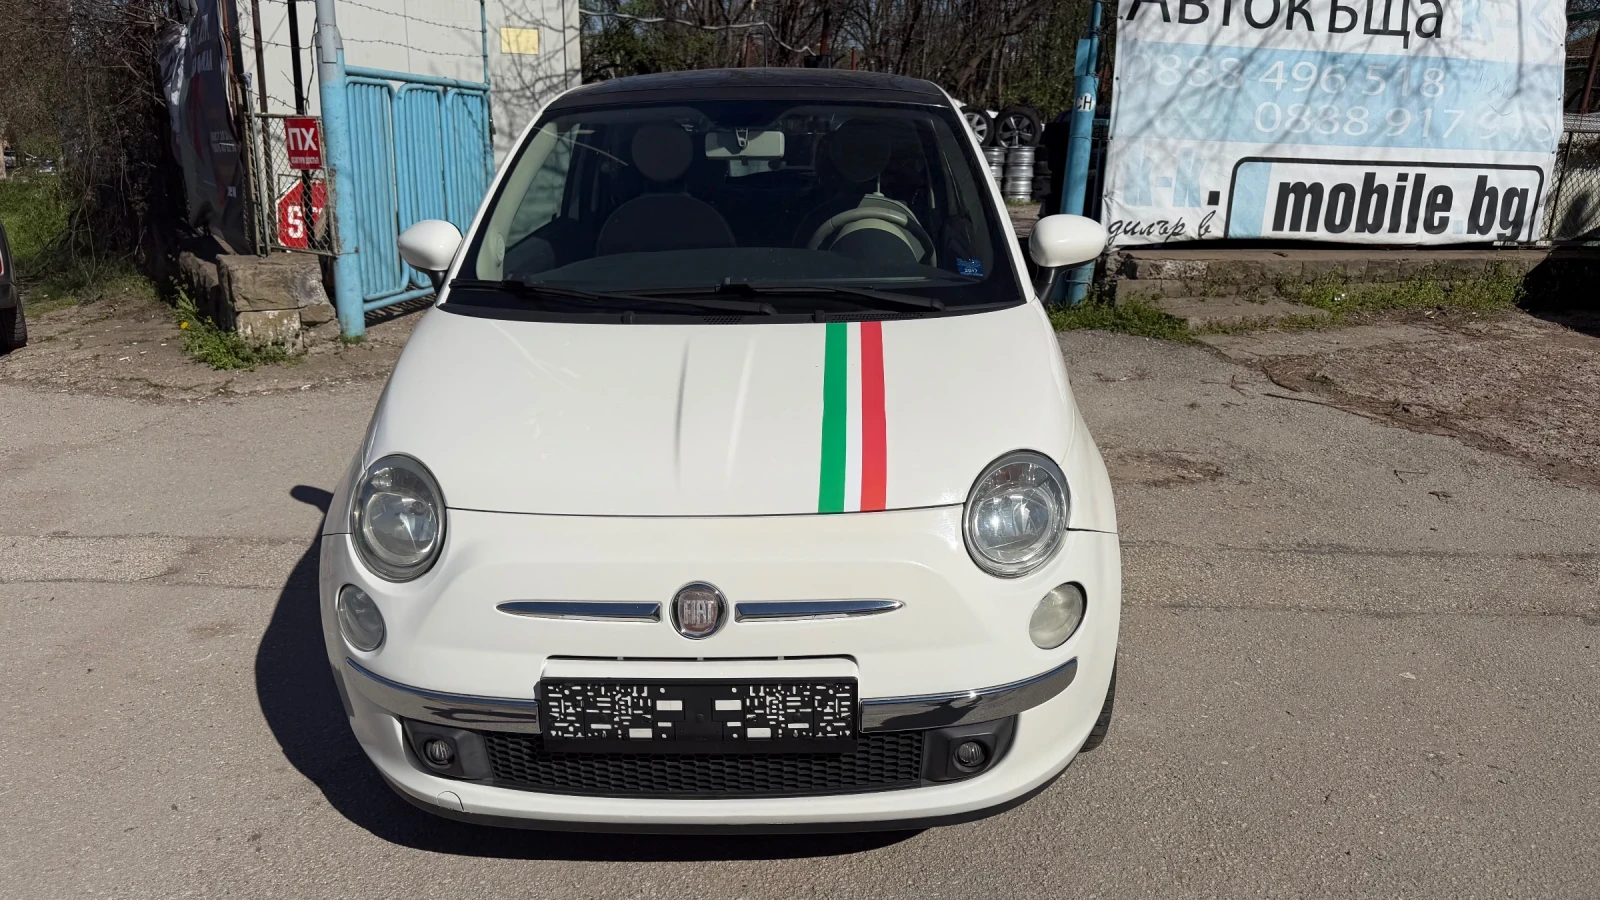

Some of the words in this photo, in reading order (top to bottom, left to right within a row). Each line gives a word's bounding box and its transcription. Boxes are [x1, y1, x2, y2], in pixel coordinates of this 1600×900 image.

[1124, 53, 1244, 90] 0888
[1259, 61, 1347, 94] 496
[1362, 65, 1445, 98] 518
[287, 127, 318, 151] ПХ
[1254, 101, 1370, 136] 0888
[1385, 107, 1466, 139] 917
[1272, 172, 1529, 241] mobile.bg
[683, 600, 714, 625] FIAT
